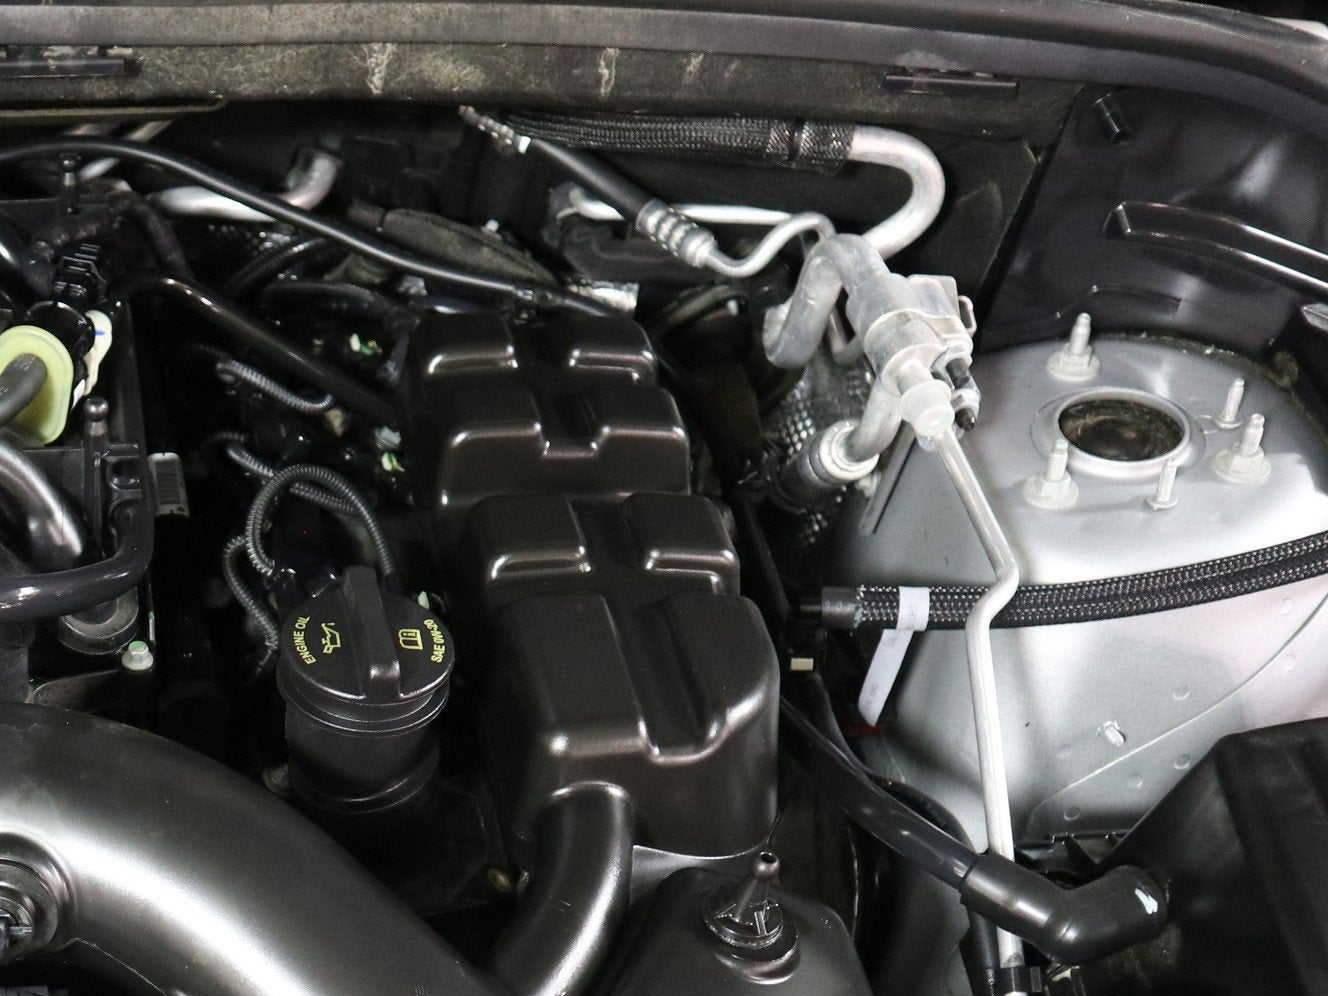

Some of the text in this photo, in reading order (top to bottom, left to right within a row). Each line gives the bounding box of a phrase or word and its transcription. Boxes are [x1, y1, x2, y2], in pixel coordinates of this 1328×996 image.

[293, 616, 317, 664] ENGINE OIL
[423, 619, 445, 663] SAE 0W-20
